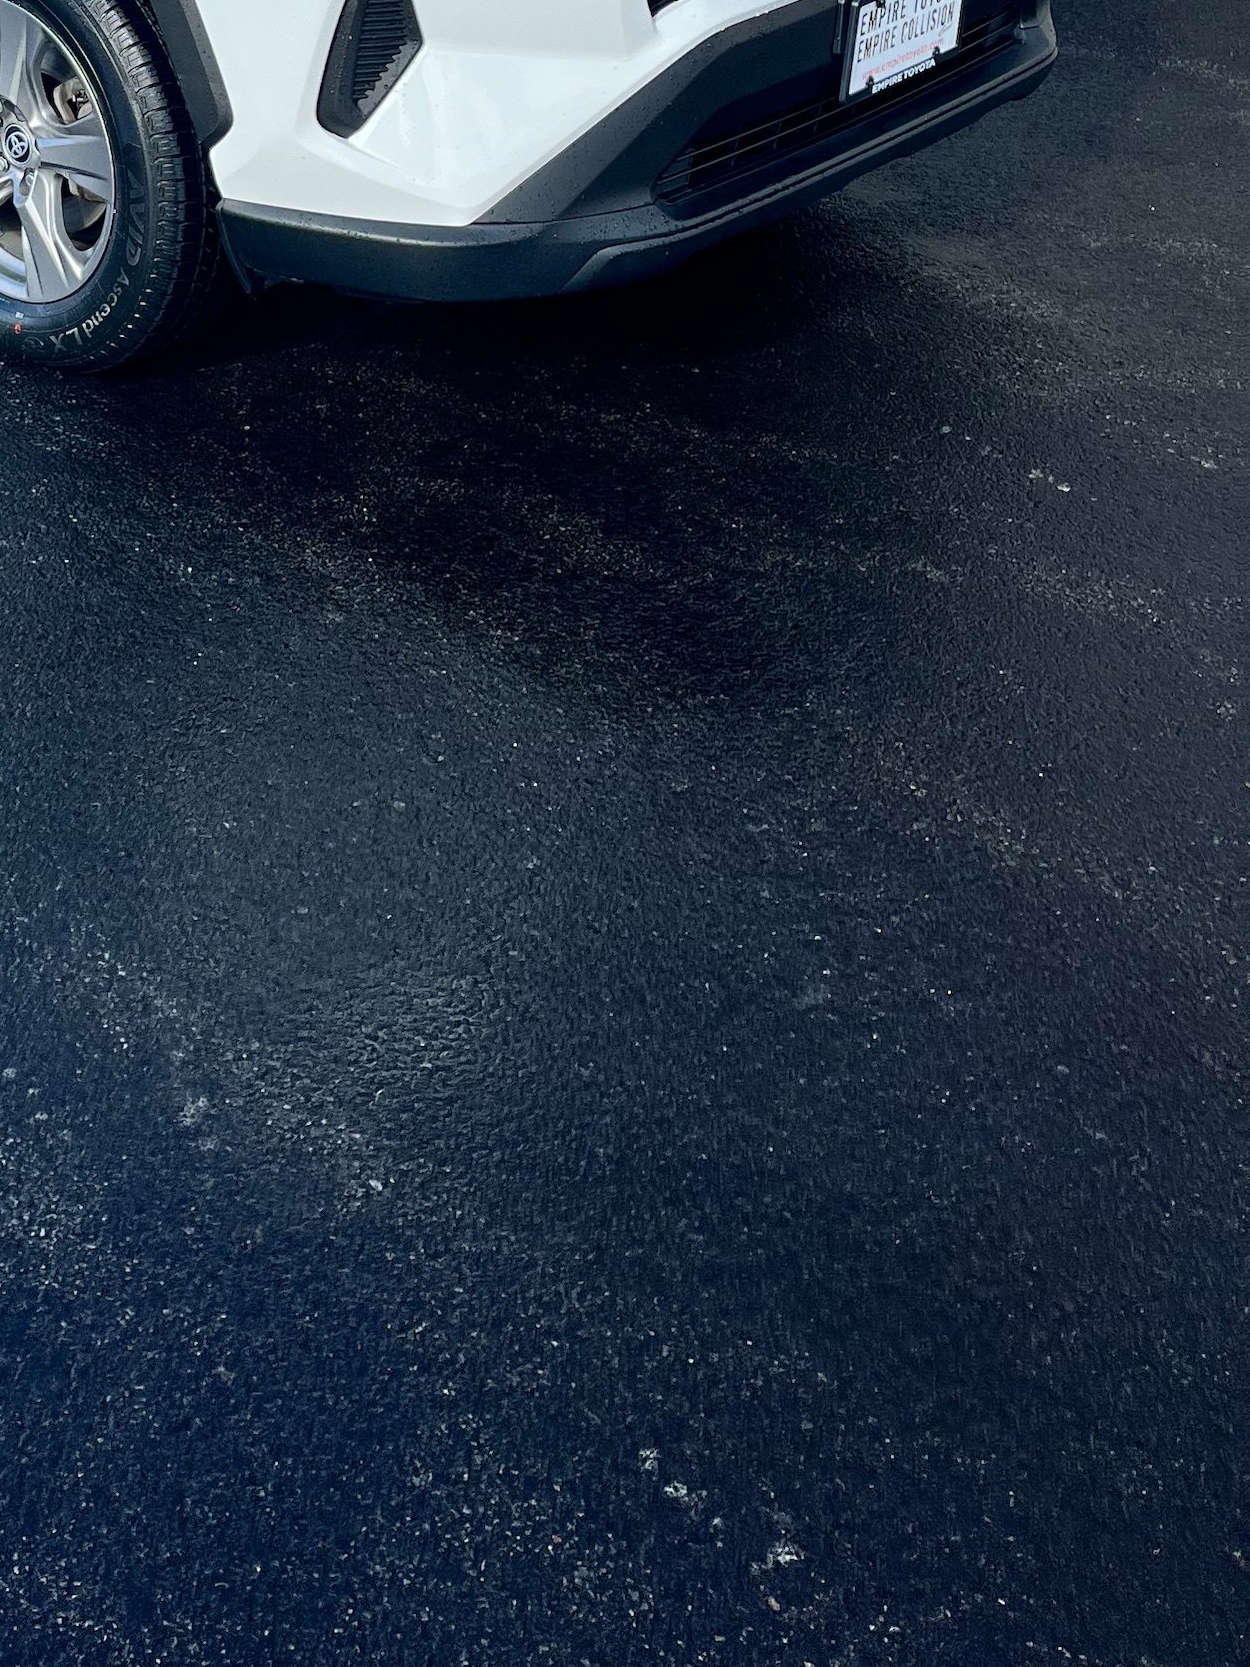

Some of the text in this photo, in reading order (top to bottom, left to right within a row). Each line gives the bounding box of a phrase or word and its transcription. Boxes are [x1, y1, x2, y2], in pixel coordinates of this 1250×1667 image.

[856, 1, 956, 64] EMPIRE COLLISION
[871, 58, 937, 94] EMPIRE TOYOTA
